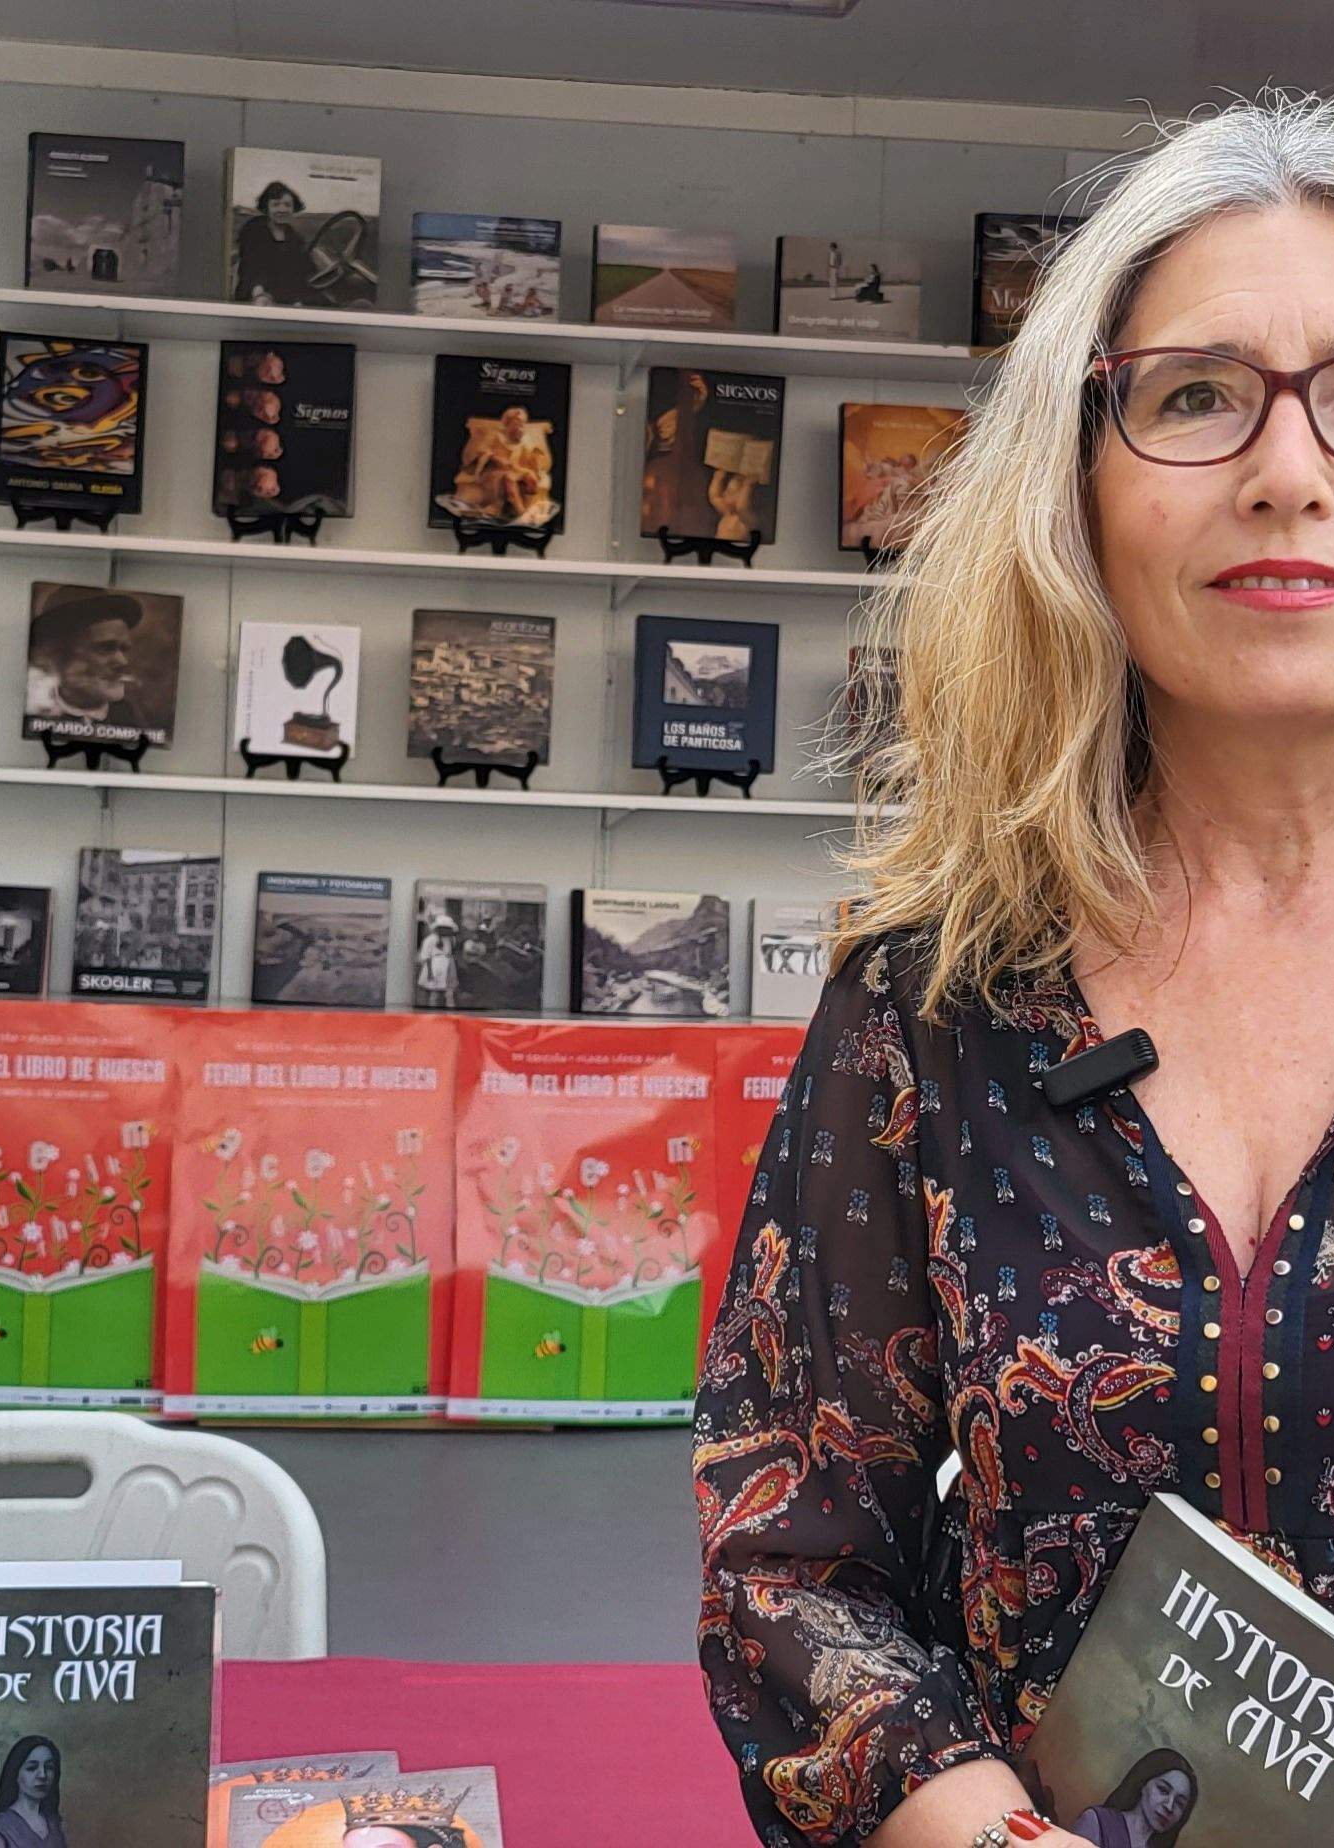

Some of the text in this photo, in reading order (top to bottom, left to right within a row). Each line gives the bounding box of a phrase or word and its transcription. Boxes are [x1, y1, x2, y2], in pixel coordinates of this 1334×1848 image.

[478, 361, 537, 386] Signos
[715, 383, 778, 402] SIGNOS
[294, 402, 349, 423] Signos
[663, 721, 726, 738] LOS BAÑOS
[662, 734, 743, 752] DE PANTICOSA
[78, 973, 153, 993] SKOGLER
[15, 1054, 68, 1082] LIBRO
[69, 1056, 94, 1083] DE
[96, 1057, 166, 1084] HUESCA
[642, 1075, 709, 1100] HUESCA
[53, 1660, 137, 1704] AVA
[1156, 1652, 1213, 1713] DE
[1224, 1693, 1334, 1802] AVA
